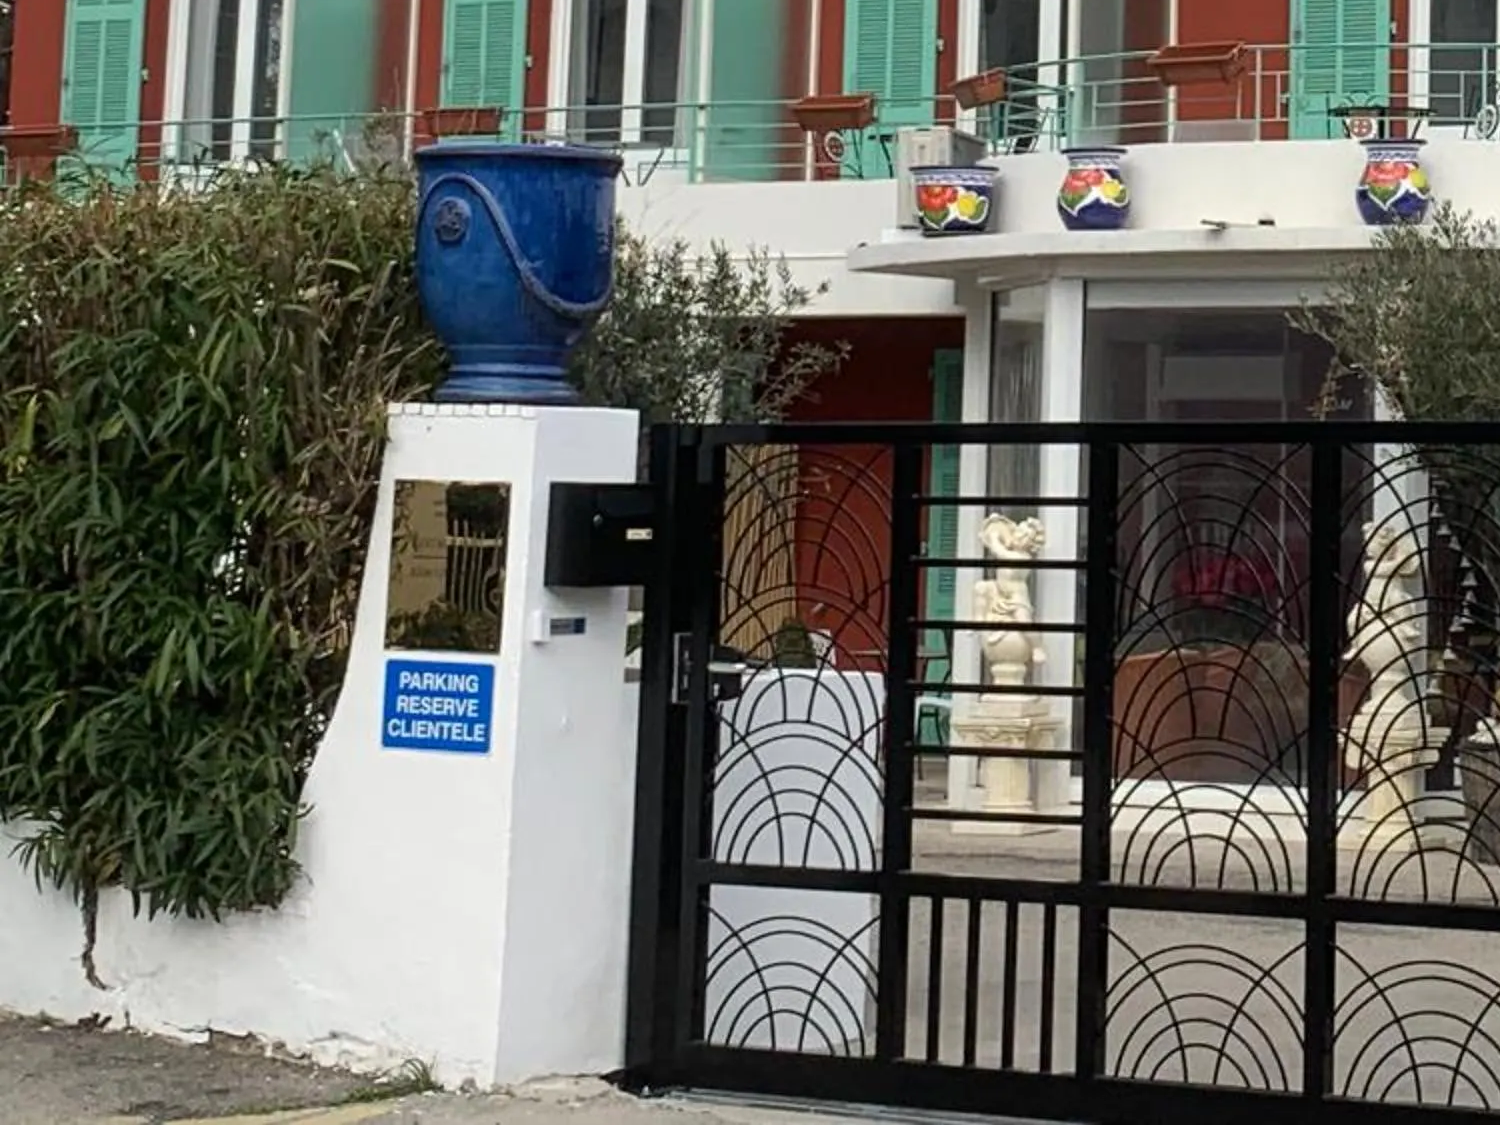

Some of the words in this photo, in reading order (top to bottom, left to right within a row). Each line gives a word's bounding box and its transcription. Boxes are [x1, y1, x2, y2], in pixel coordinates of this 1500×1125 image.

[399, 671, 480, 693] PARKING
[396, 694, 480, 718] RESERVE
[387, 718, 486, 742] CLIENTELE
